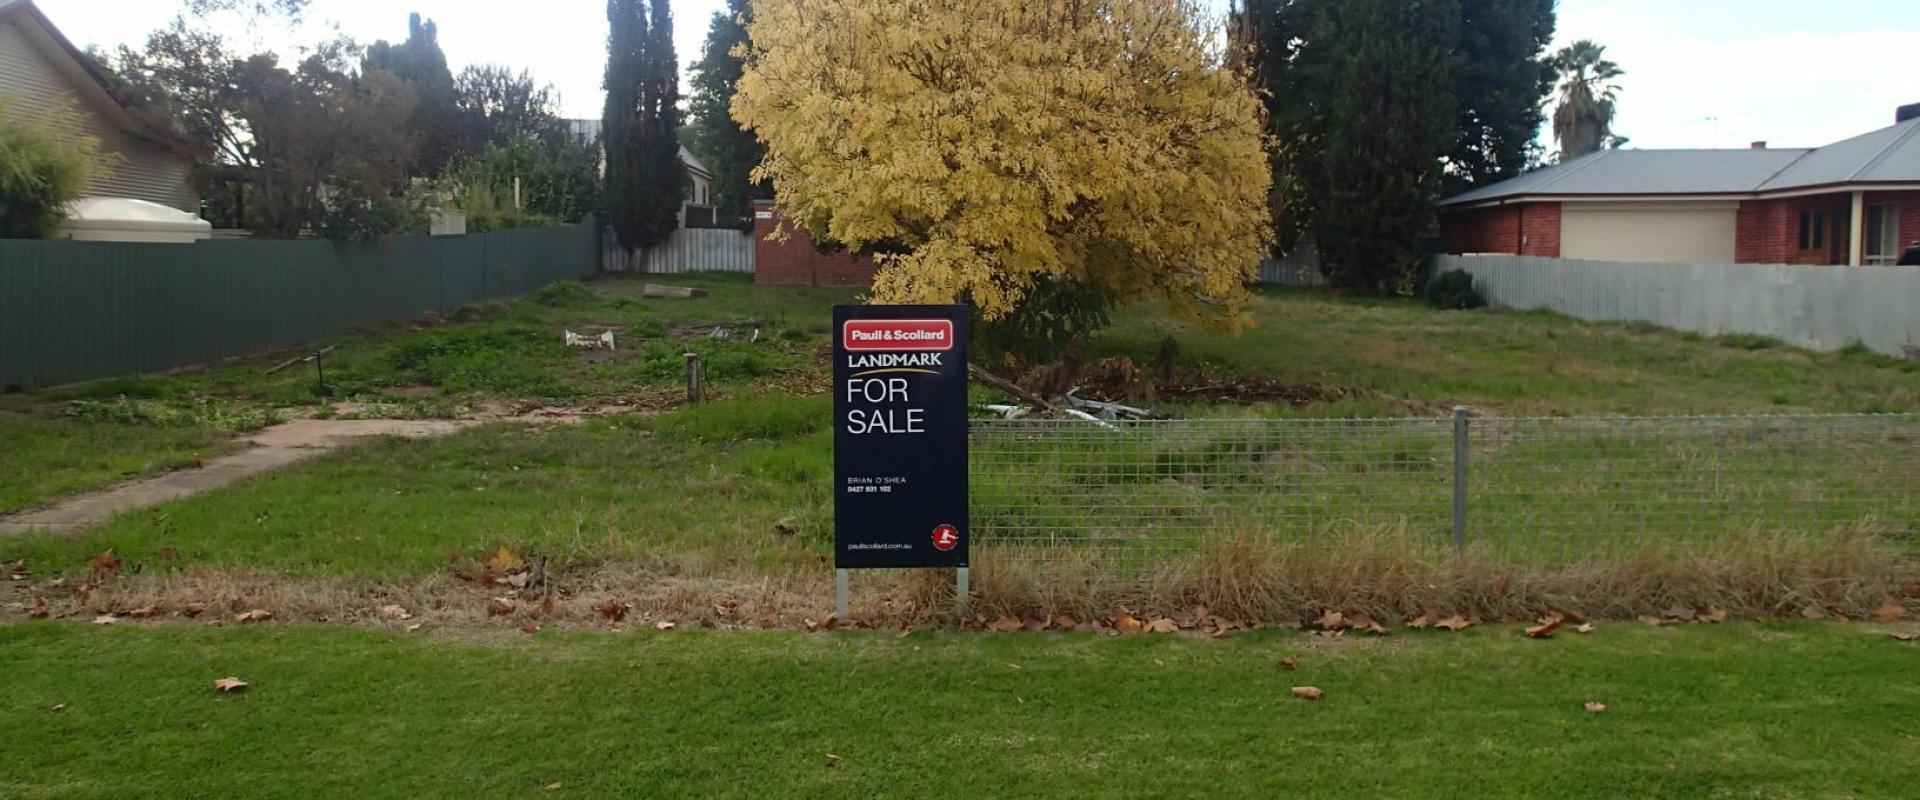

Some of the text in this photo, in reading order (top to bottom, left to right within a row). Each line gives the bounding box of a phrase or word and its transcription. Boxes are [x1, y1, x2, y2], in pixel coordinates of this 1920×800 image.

[851, 329, 945, 340] Paull & Scollard
[848, 352, 943, 368] LANDMARK
[847, 378, 909, 403] FOR
[847, 409, 925, 434] SALE
